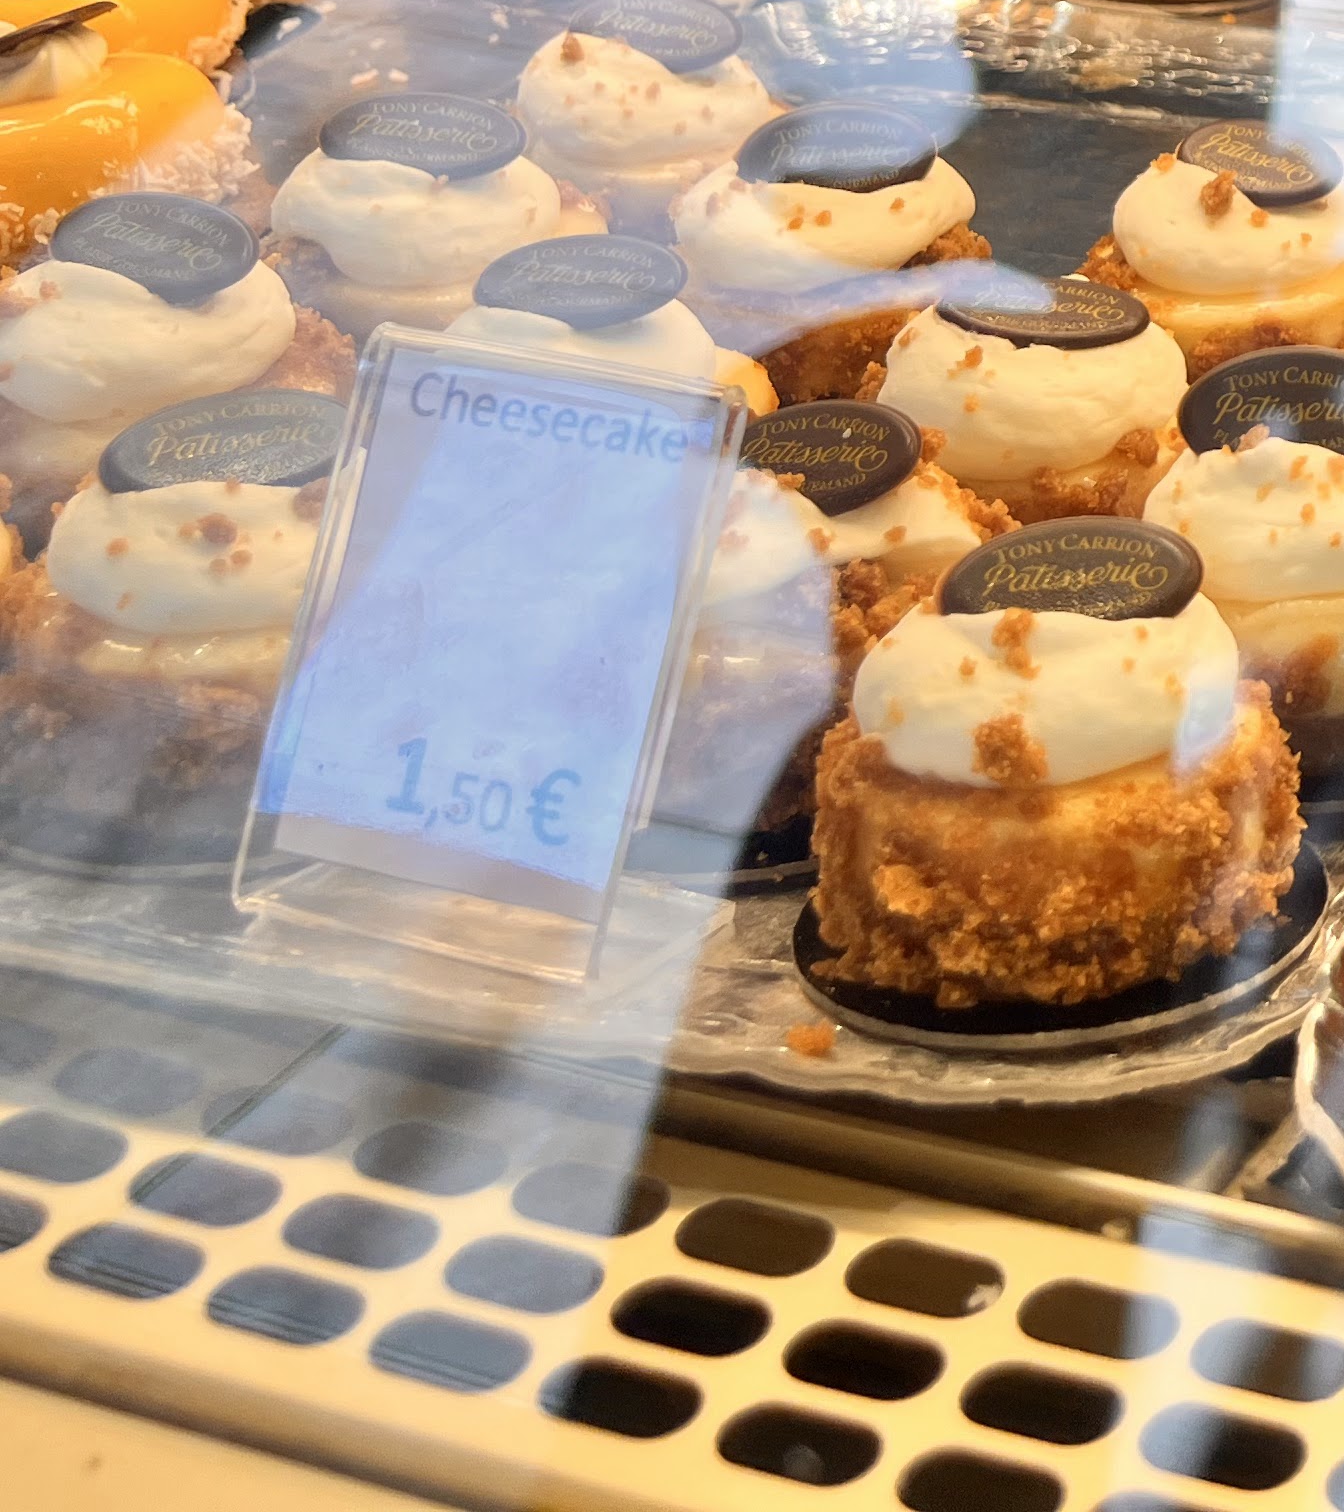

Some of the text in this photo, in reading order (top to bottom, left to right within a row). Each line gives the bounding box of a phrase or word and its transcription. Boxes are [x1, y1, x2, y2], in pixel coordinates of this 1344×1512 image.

[1223, 124, 1267, 141] TONY
[1199, 133, 1315, 185] Patisserie
[82, 213, 223, 272] Patisserie
[1223, 370, 1280, 393] TONY
[151, 402, 327, 438] TONY CARRION
[410, 371, 689, 464] Cheesecake
[758, 413, 891, 442] TONY CARRION
[145, 420, 342, 468] Patisserie
[739, 438, 888, 473] Patisserie
[992, 536, 1159, 564] TONY CARRION
[980, 557, 1169, 598] Patisserie
[385, 736, 582, 848] 1,50 €
